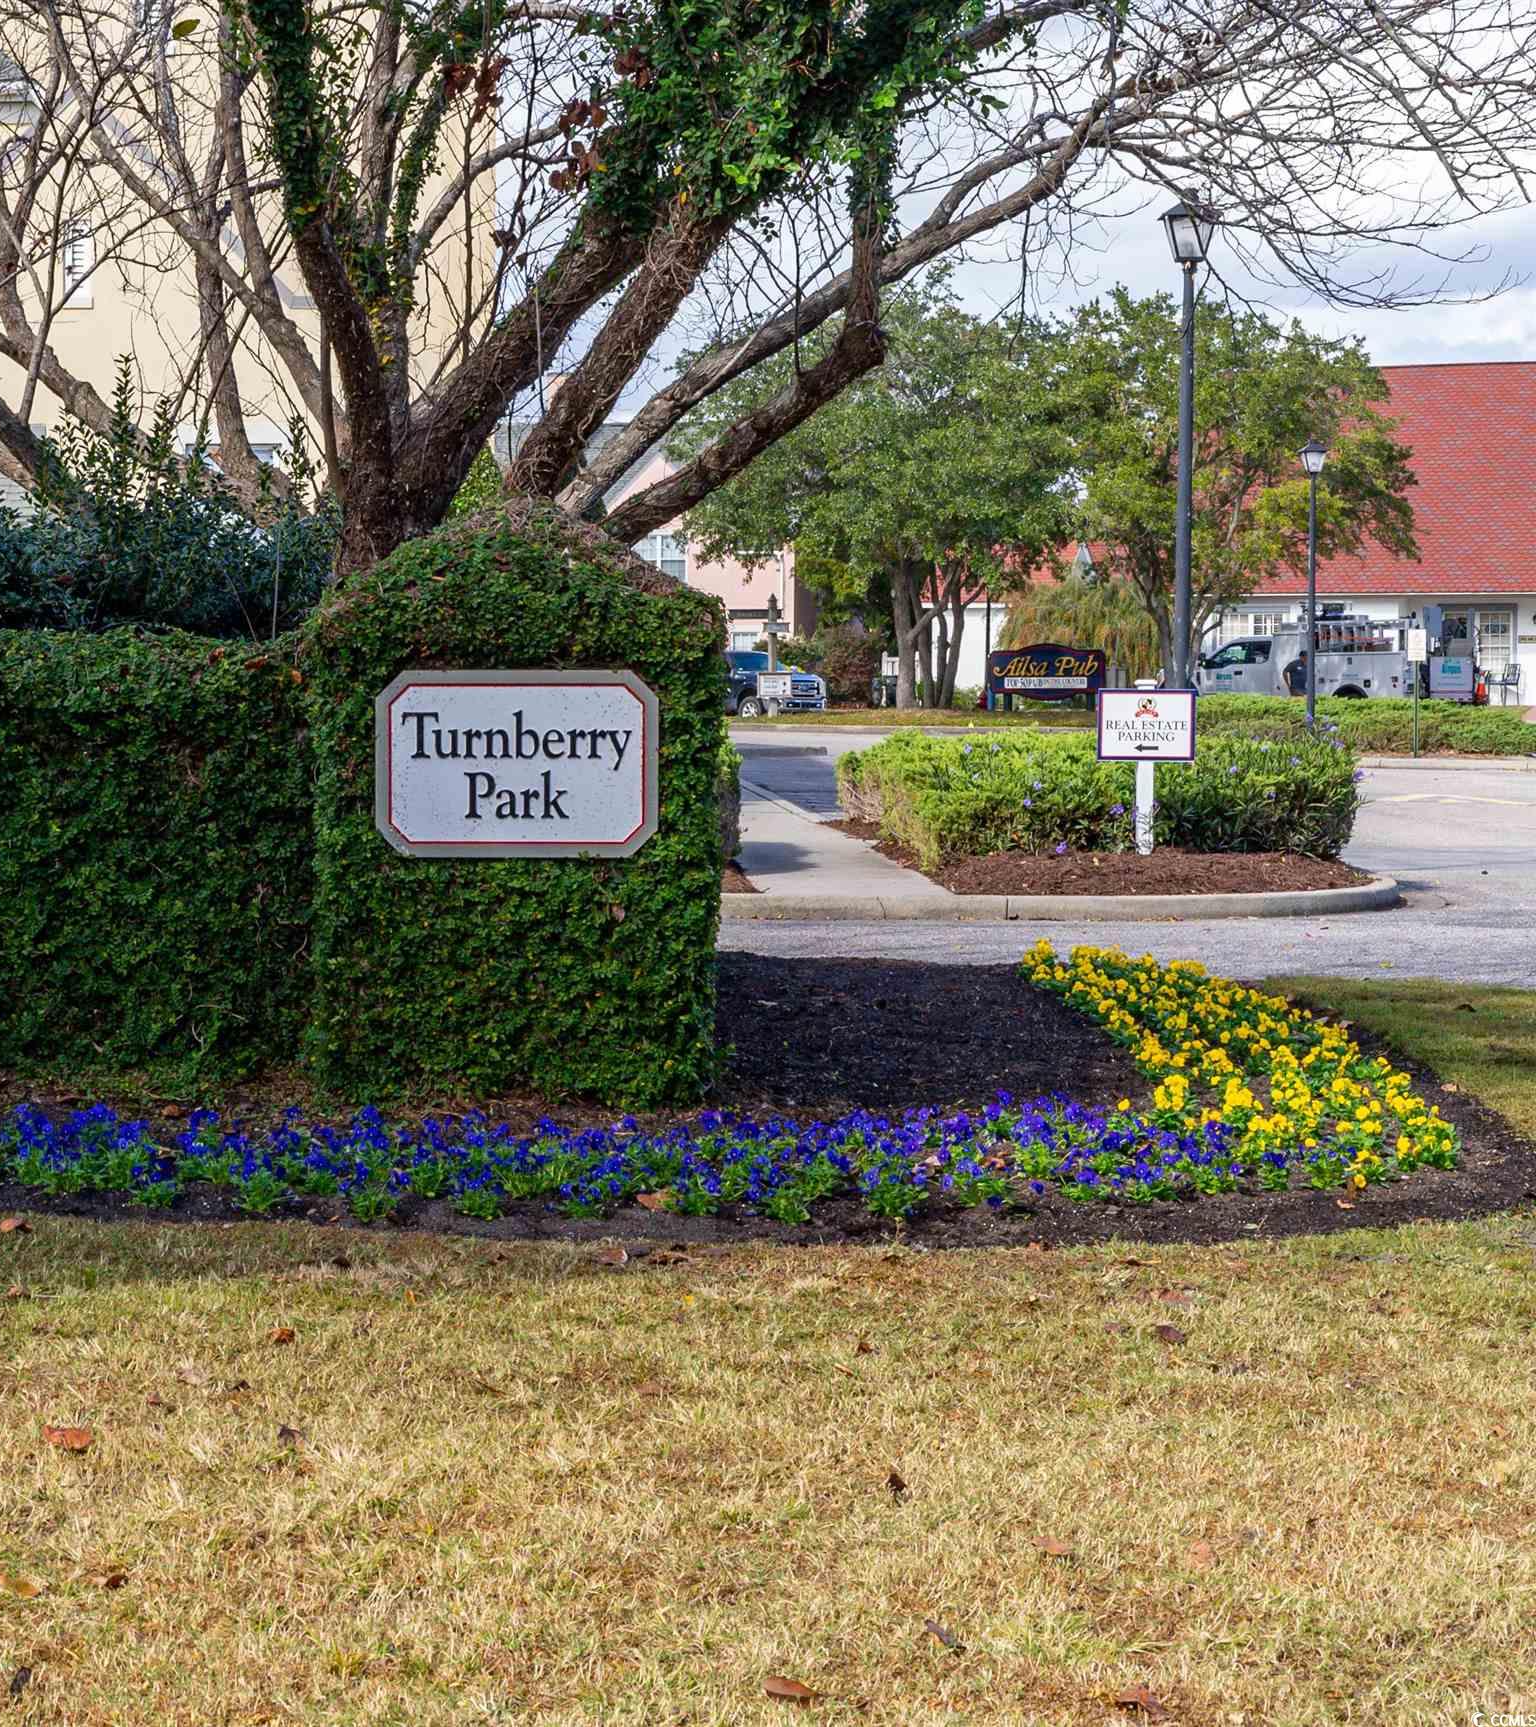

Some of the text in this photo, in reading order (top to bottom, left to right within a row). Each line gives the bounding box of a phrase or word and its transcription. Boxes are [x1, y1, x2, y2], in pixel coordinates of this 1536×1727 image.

[992, 655, 1099, 677] Ailsa Pub
[1105, 720, 1188, 731] REAL ESTATE
[1118, 731, 1175, 742] PARKING
[401, 710, 632, 771] Turnberry
[464, 770, 569, 819] Park
